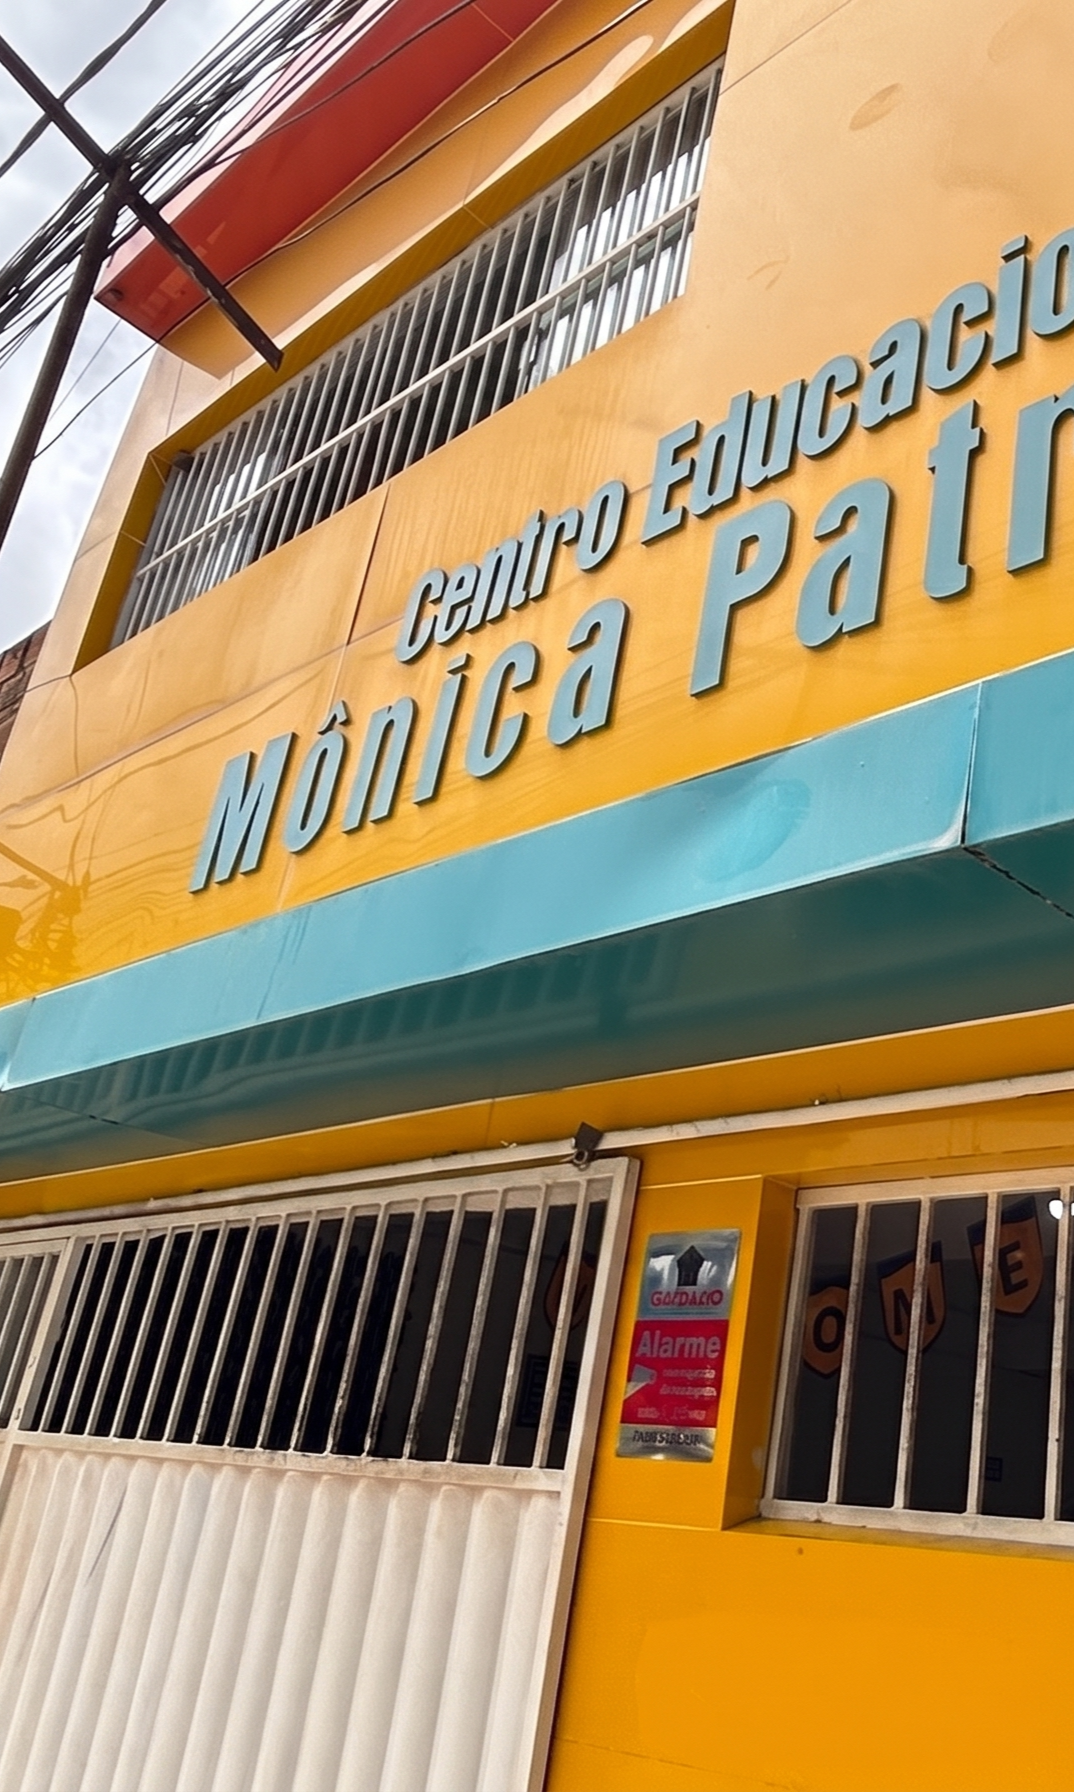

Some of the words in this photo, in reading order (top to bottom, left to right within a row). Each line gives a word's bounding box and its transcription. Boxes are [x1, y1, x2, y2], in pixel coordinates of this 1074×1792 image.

[395, 480, 630, 665] Centro
[189, 597, 633, 894] Mônica
[635, 1330, 722, 1359] Alarme
